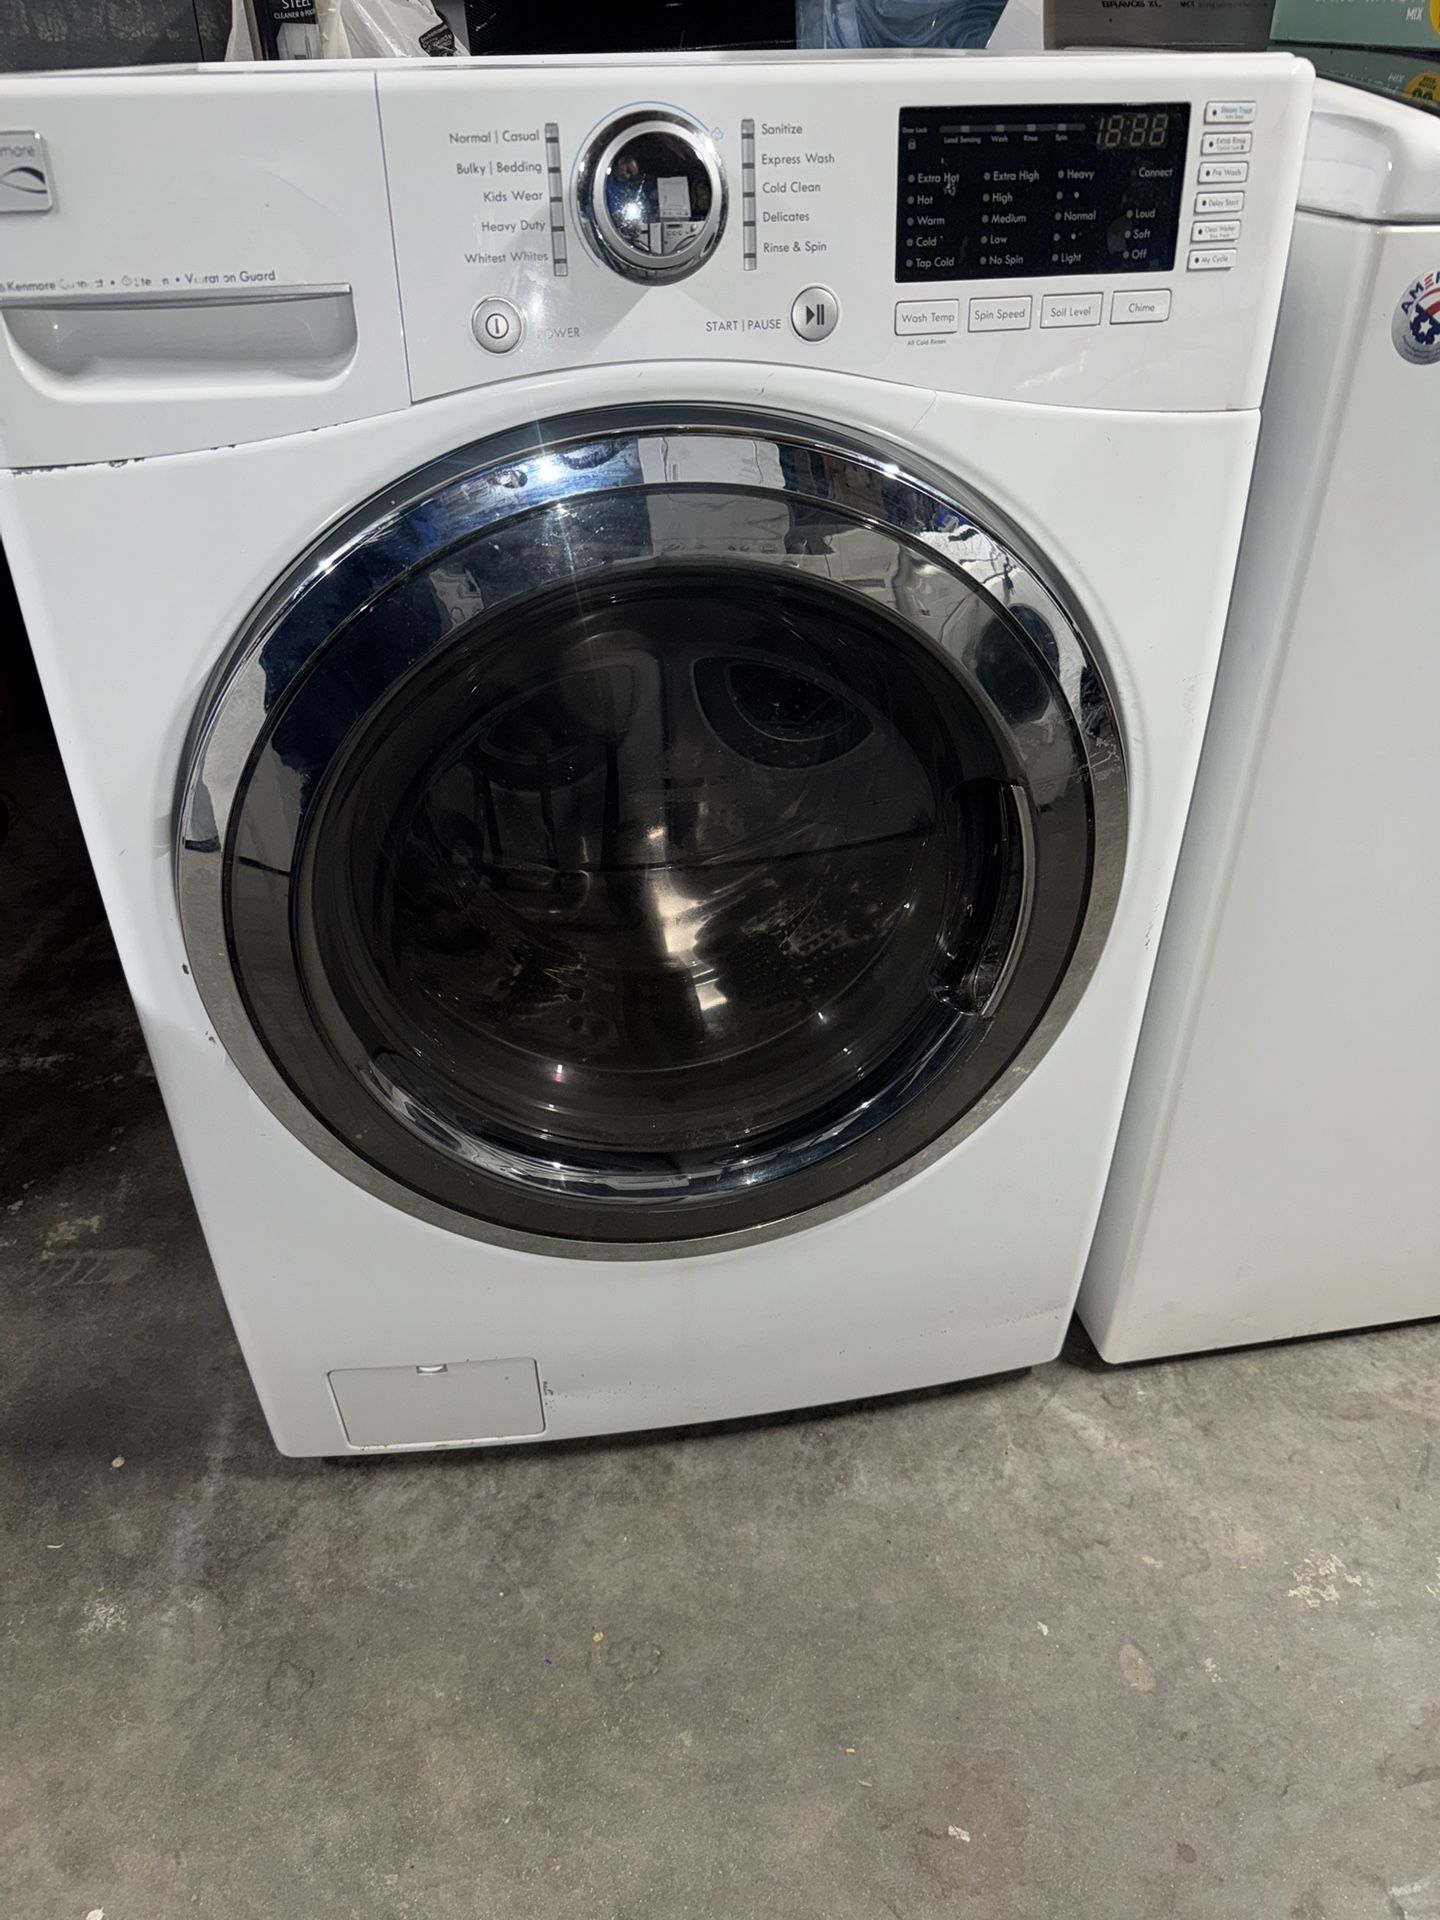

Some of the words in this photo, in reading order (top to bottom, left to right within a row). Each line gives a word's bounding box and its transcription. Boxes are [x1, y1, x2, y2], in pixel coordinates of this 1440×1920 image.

[1406, 7, 1424, 20] MIX
[761, 123, 803, 135] Sanitize
[449, 131, 492, 144] Normal
[502, 129, 540, 143] Casual
[1055, 134, 1068, 142] Spin
[761, 153, 802, 167] Express
[804, 153, 835, 164] Wash
[456, 162, 486, 176] Bulky
[497, 160, 542, 174] Bedding
[1138, 167, 1173, 177] Connect
[1212, 168, 1222, 176] Pre
[1224, 168, 1242, 176] Wash
[917, 173, 941, 184] Extra
[943, 172, 960, 184] Hot
[993, 171, 1016, 182] Extra
[1018, 170, 1040, 183] High
[1066, 169, 1095, 181] Heavy
[763, 181, 792, 193] Cold
[794, 181, 821, 193] Clean
[483, 191, 508, 203] Kids
[511, 189, 543, 201] Wear
[917, 195, 933, 206] Hot
[992, 192, 1013, 204] High
[763, 211, 810, 223] Delicates
[991, 213, 1026, 224] Medium
[1064, 211, 1096, 222] Normal
[1135, 208, 1156, 219] Loud
[916, 215, 945, 226] Warm
[481, 220, 516, 235] Heavy
[520, 219, 546, 233] Duty
[990, 234, 1008, 245] Low
[1132, 229, 1151, 240] Soft
[763, 241, 789, 253] Rinse
[793, 242, 801, 252] &
[804, 240, 827, 254] Spin
[916, 237, 937, 248] Cold
[464, 252, 506, 264] Whitest
[508, 250, 549, 263] Whites
[989, 255, 1002, 266] No
[1004, 254, 1024, 267] Spin
[1061, 252, 1082, 265] Light
[1131, 249, 1148, 260] Off
[1201, 256, 1211, 264] My
[1212, 255, 1229, 264] Cycle
[916, 258, 932, 270] Tap
[934, 256, 955, 268] Cold
[239, 270, 275, 282] Guard
[7, 281, 55, 291] Kenmore
[1050, 306, 1068, 318] Soil
[1069, 305, 1091, 317] Level
[1128, 302, 1156, 314] Chime
[901, 313, 928, 324] Wash
[931, 312, 955, 324] Temp
[974, 310, 994, 322] Spin
[997, 308, 1025, 321] Speed
[706, 321, 739, 332] START
[747, 318, 781, 331] PAUSE
